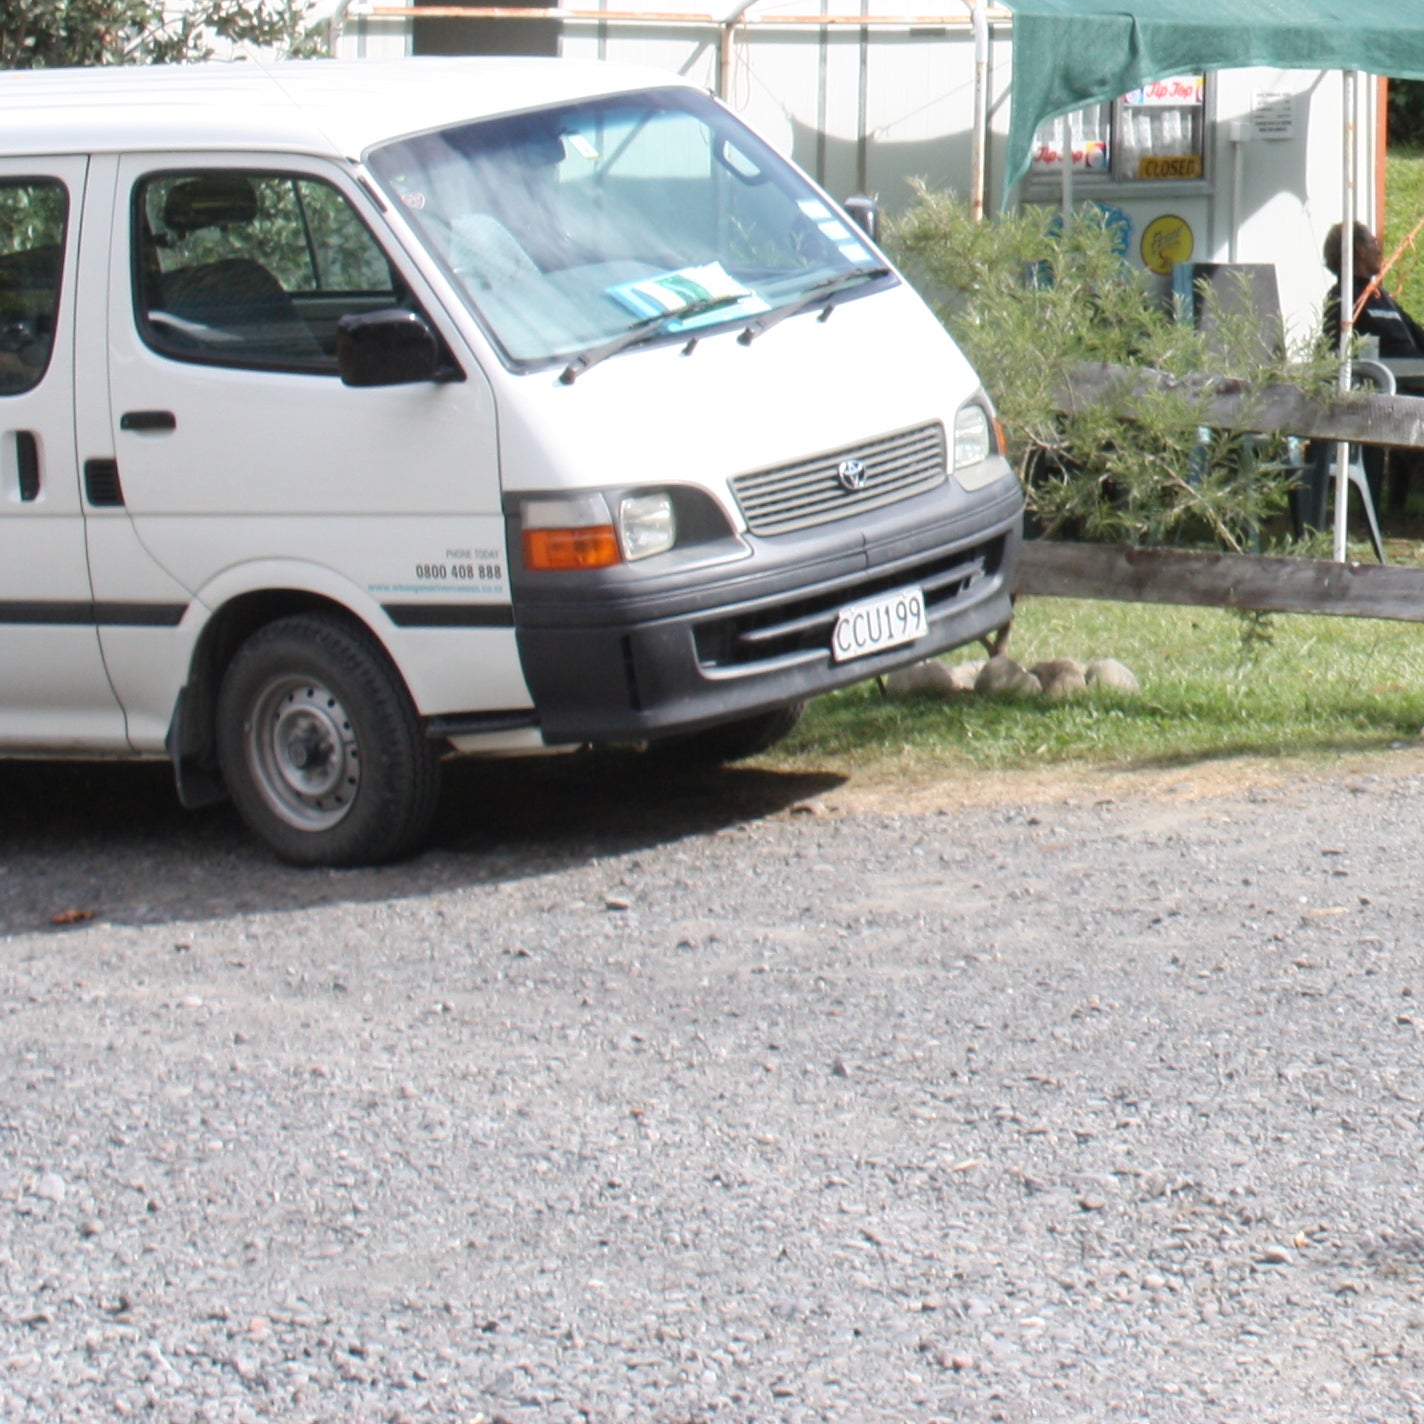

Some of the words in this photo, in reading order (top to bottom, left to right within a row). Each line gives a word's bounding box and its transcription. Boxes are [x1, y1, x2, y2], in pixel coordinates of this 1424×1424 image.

[1145, 159, 1196, 177] CLOSED
[416, 564, 447, 579] 0800
[451, 564, 474, 579] 408
[478, 564, 502, 579] 888
[837, 596, 921, 652] CCU199
